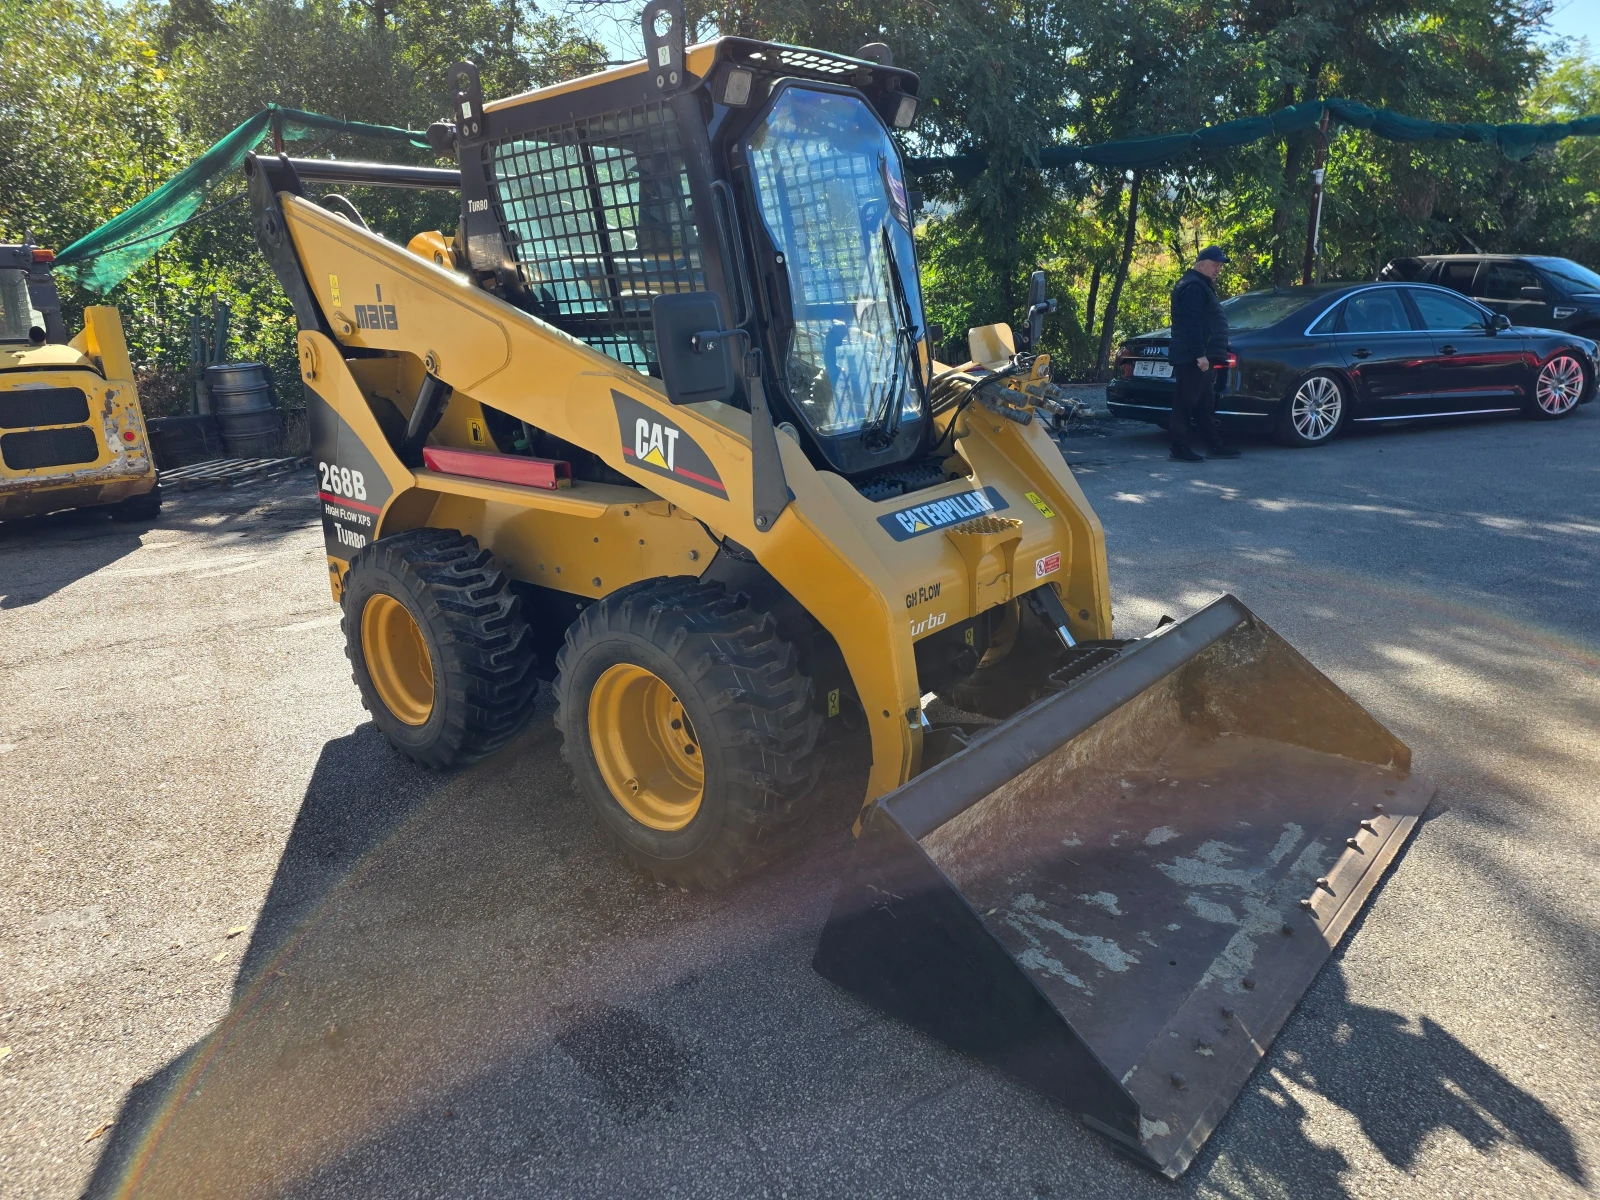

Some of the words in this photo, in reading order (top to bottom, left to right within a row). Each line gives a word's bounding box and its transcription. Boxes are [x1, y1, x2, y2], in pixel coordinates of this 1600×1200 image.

[467, 199, 488, 213] TURBO
[635, 418, 679, 472] CAT
[319, 461, 367, 501] 268B
[325, 504, 339, 517] HIGH
[340, 508, 357, 522] FLOW
[357, 514, 371, 526] XPS
[895, 491, 994, 534] CATERPILLAR
[919, 582, 940, 604] FLOW
[910, 613, 946, 636] urbo
